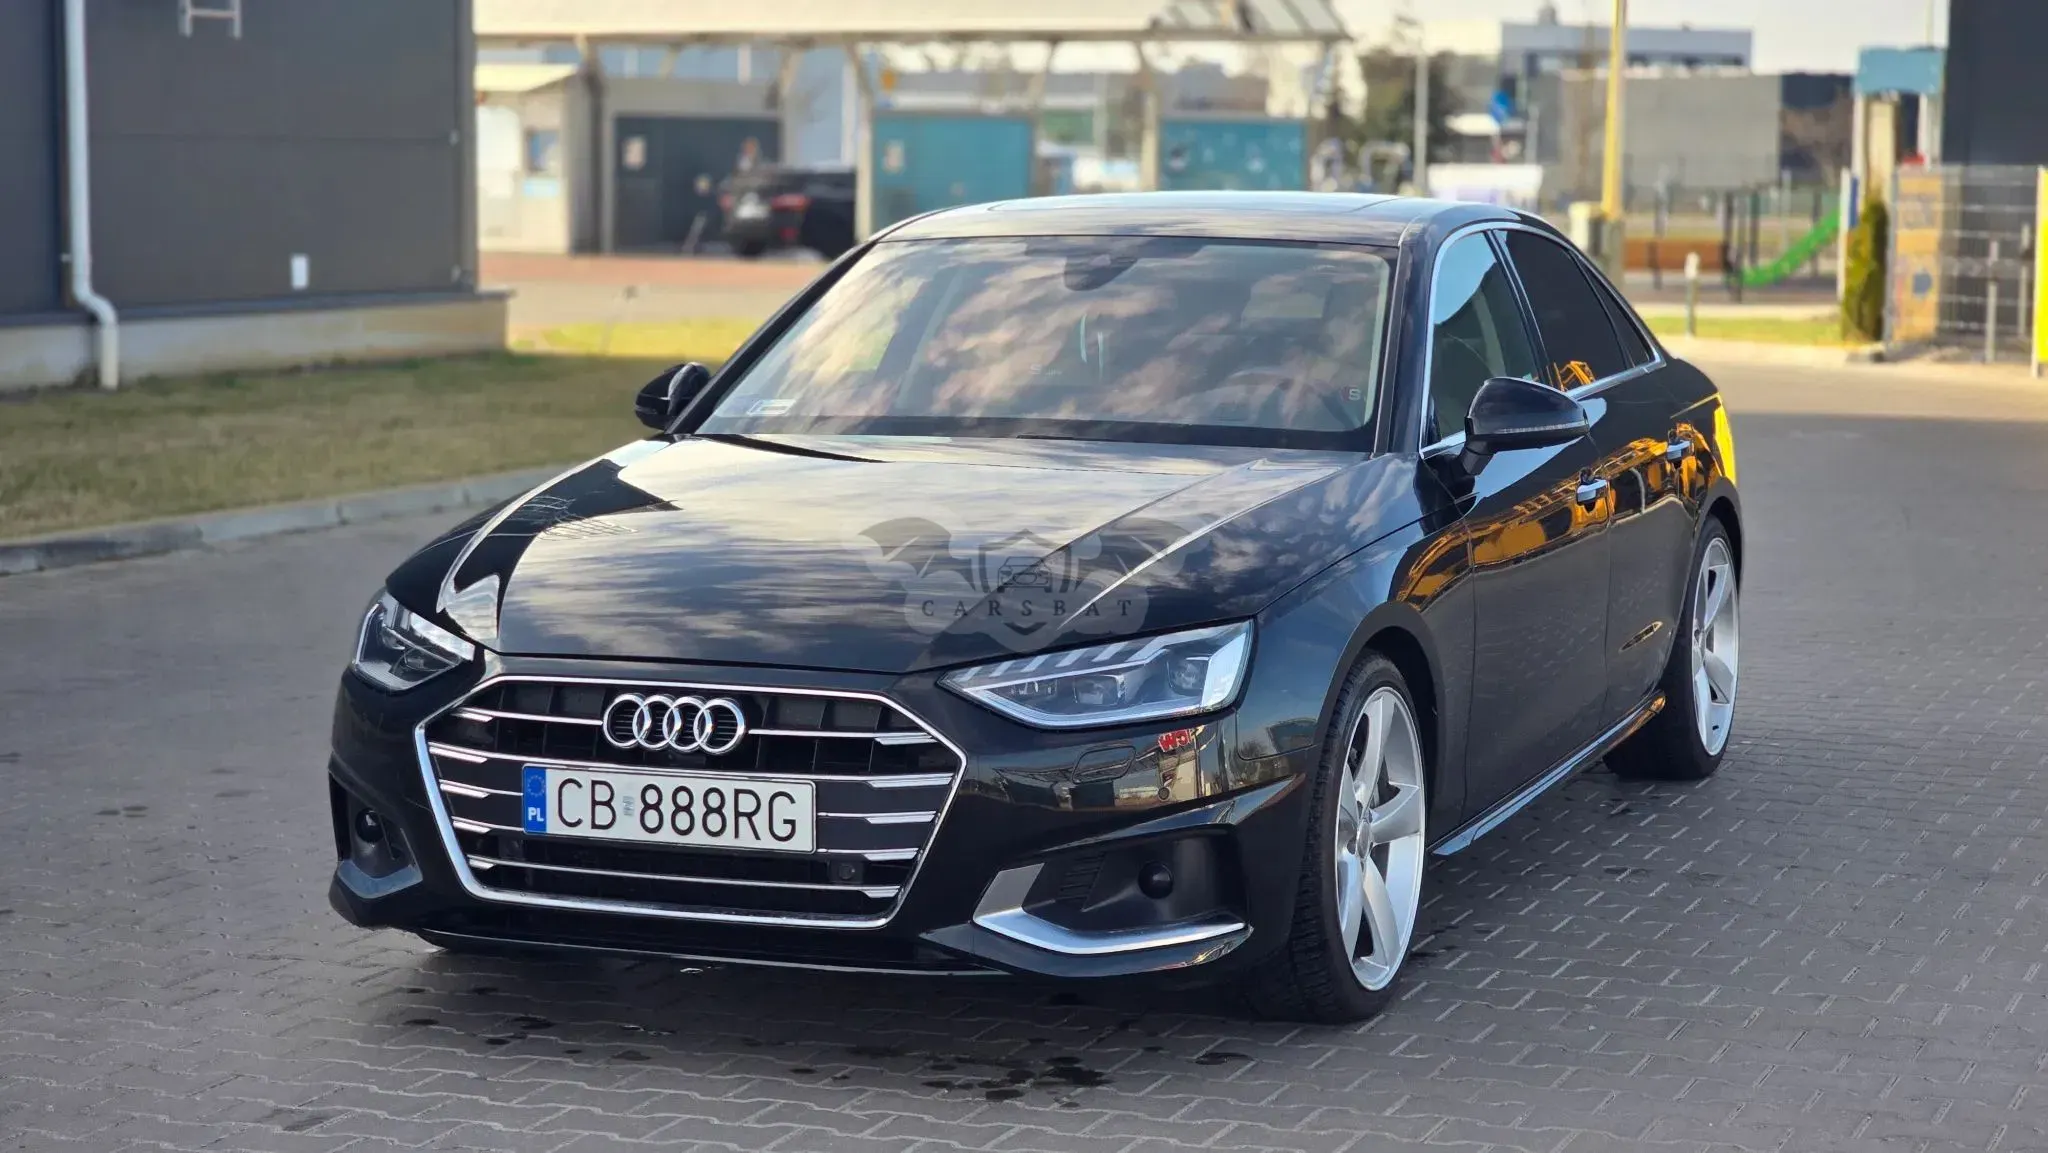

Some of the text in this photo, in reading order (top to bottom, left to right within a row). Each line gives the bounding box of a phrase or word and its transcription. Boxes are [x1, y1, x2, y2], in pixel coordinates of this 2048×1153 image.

[527, 807, 544, 822] PL
[558, 778, 796, 842] CB 888RG
